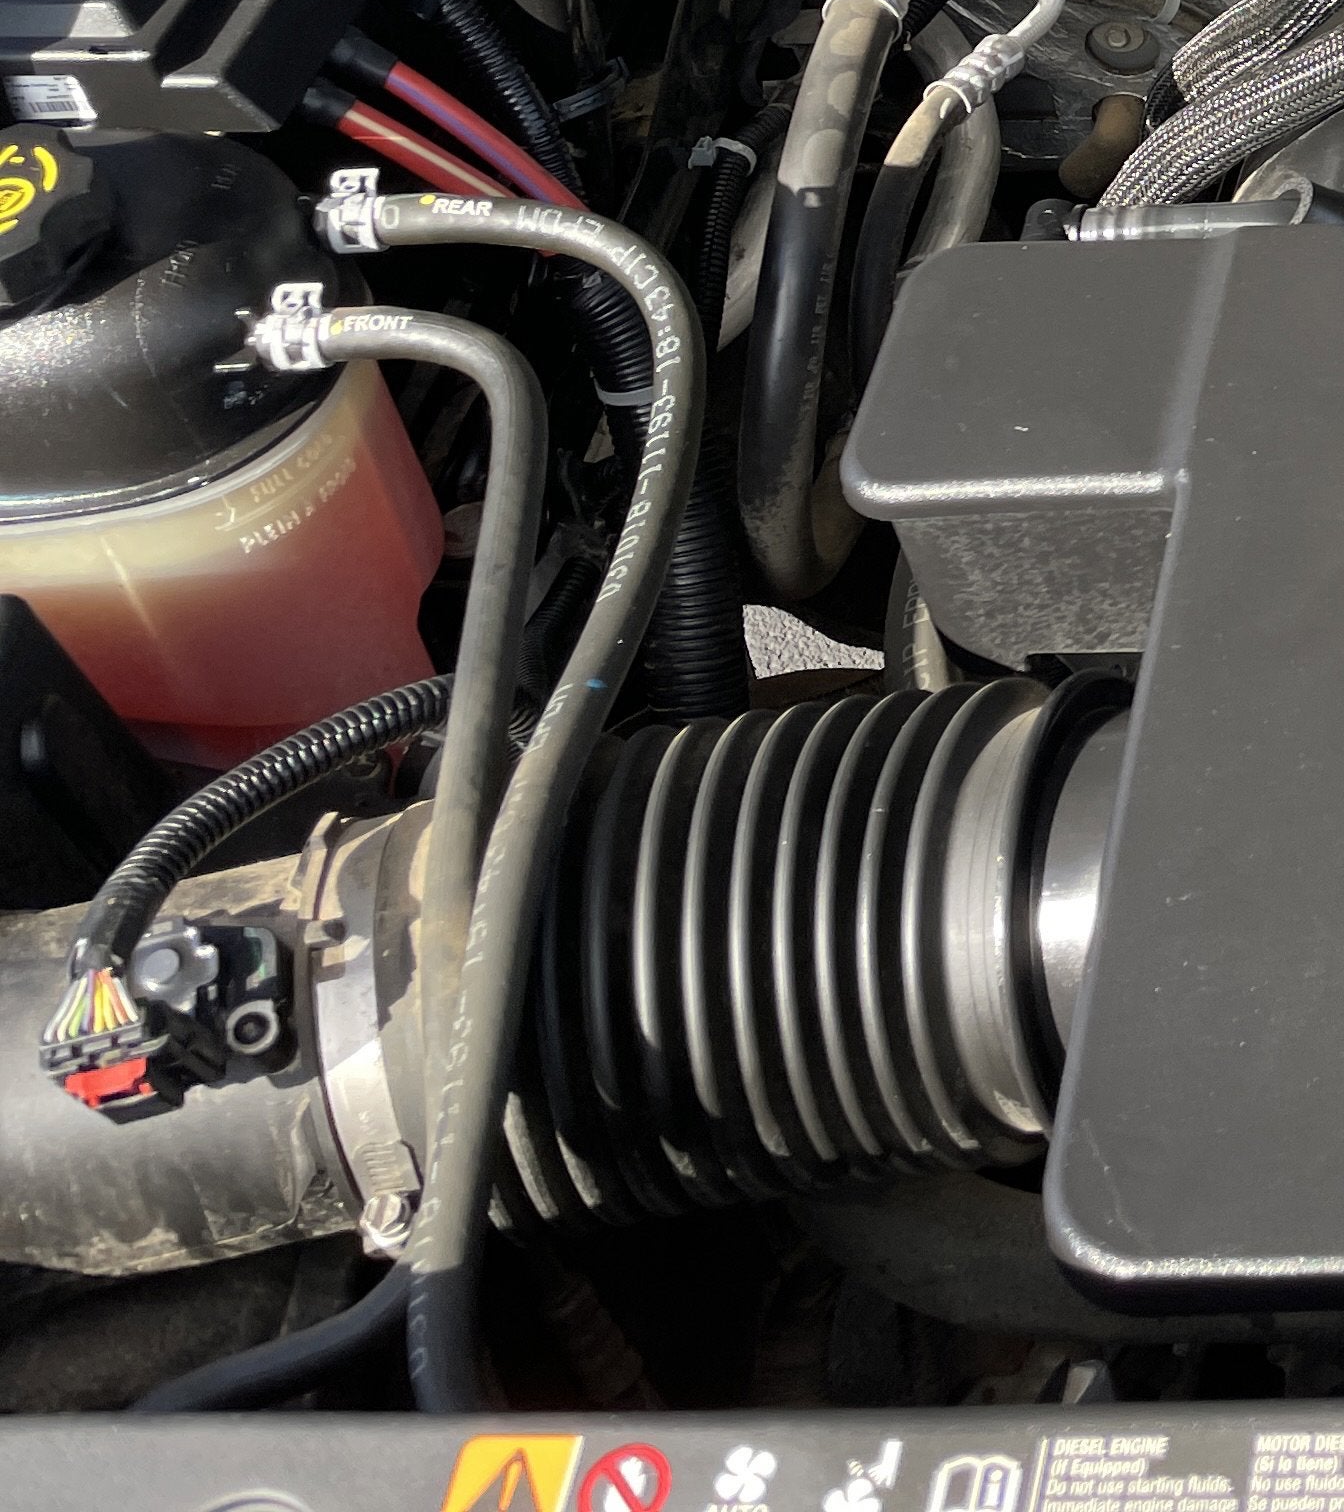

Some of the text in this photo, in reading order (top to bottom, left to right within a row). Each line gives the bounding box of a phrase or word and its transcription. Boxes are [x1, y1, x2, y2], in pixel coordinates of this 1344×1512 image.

[432, 197, 494, 217] REAR
[343, 314, 414, 332] FRONT
[250, 468, 294, 503] FULL
[1053, 1436, 1169, 1455] DIESEL ENGINE
[1256, 1434, 1311, 1452] MOTOR
[1071, 1458, 1146, 1477] Equipped)
[1254, 1455, 1274, 1473] (Si
[1295, 1455, 1339, 1473] tiene)
[1047, 1474, 1232, 1497] Do not use starting fluids.
[1250, 1475, 1271, 1492] No
[1275, 1477, 1302, 1492] use
[1043, 1497, 1238, 1512] Immediate engine damage
[1248, 1495, 1267, 1511] Se
[1271, 1495, 1325, 1512] pueden
